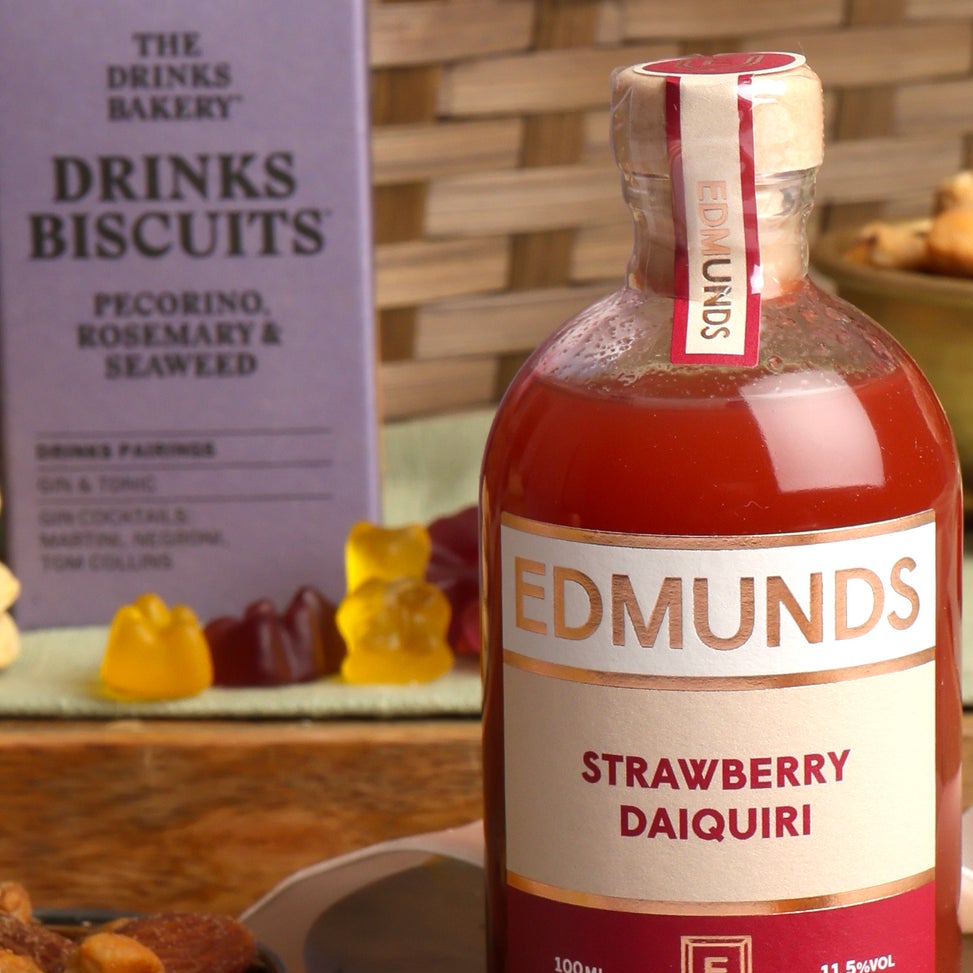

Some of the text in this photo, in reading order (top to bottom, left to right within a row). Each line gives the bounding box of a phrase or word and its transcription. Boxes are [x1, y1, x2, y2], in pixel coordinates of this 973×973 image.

[133, 32, 201, 57] THE
[106, 64, 232, 90] DRINKS
[53, 153, 296, 202] DRINKS
[696, 180, 733, 340] EDMUNDS
[94, 291, 270, 316] PECORINO,
[77, 322, 282, 349] ROSEMARY &
[105, 353, 258, 379] SEAWEED
[514, 556, 920, 650] EDMUNDS
[582, 749, 851, 790] STRAWBERRY
[620, 804, 811, 842] DAIQUIRI
